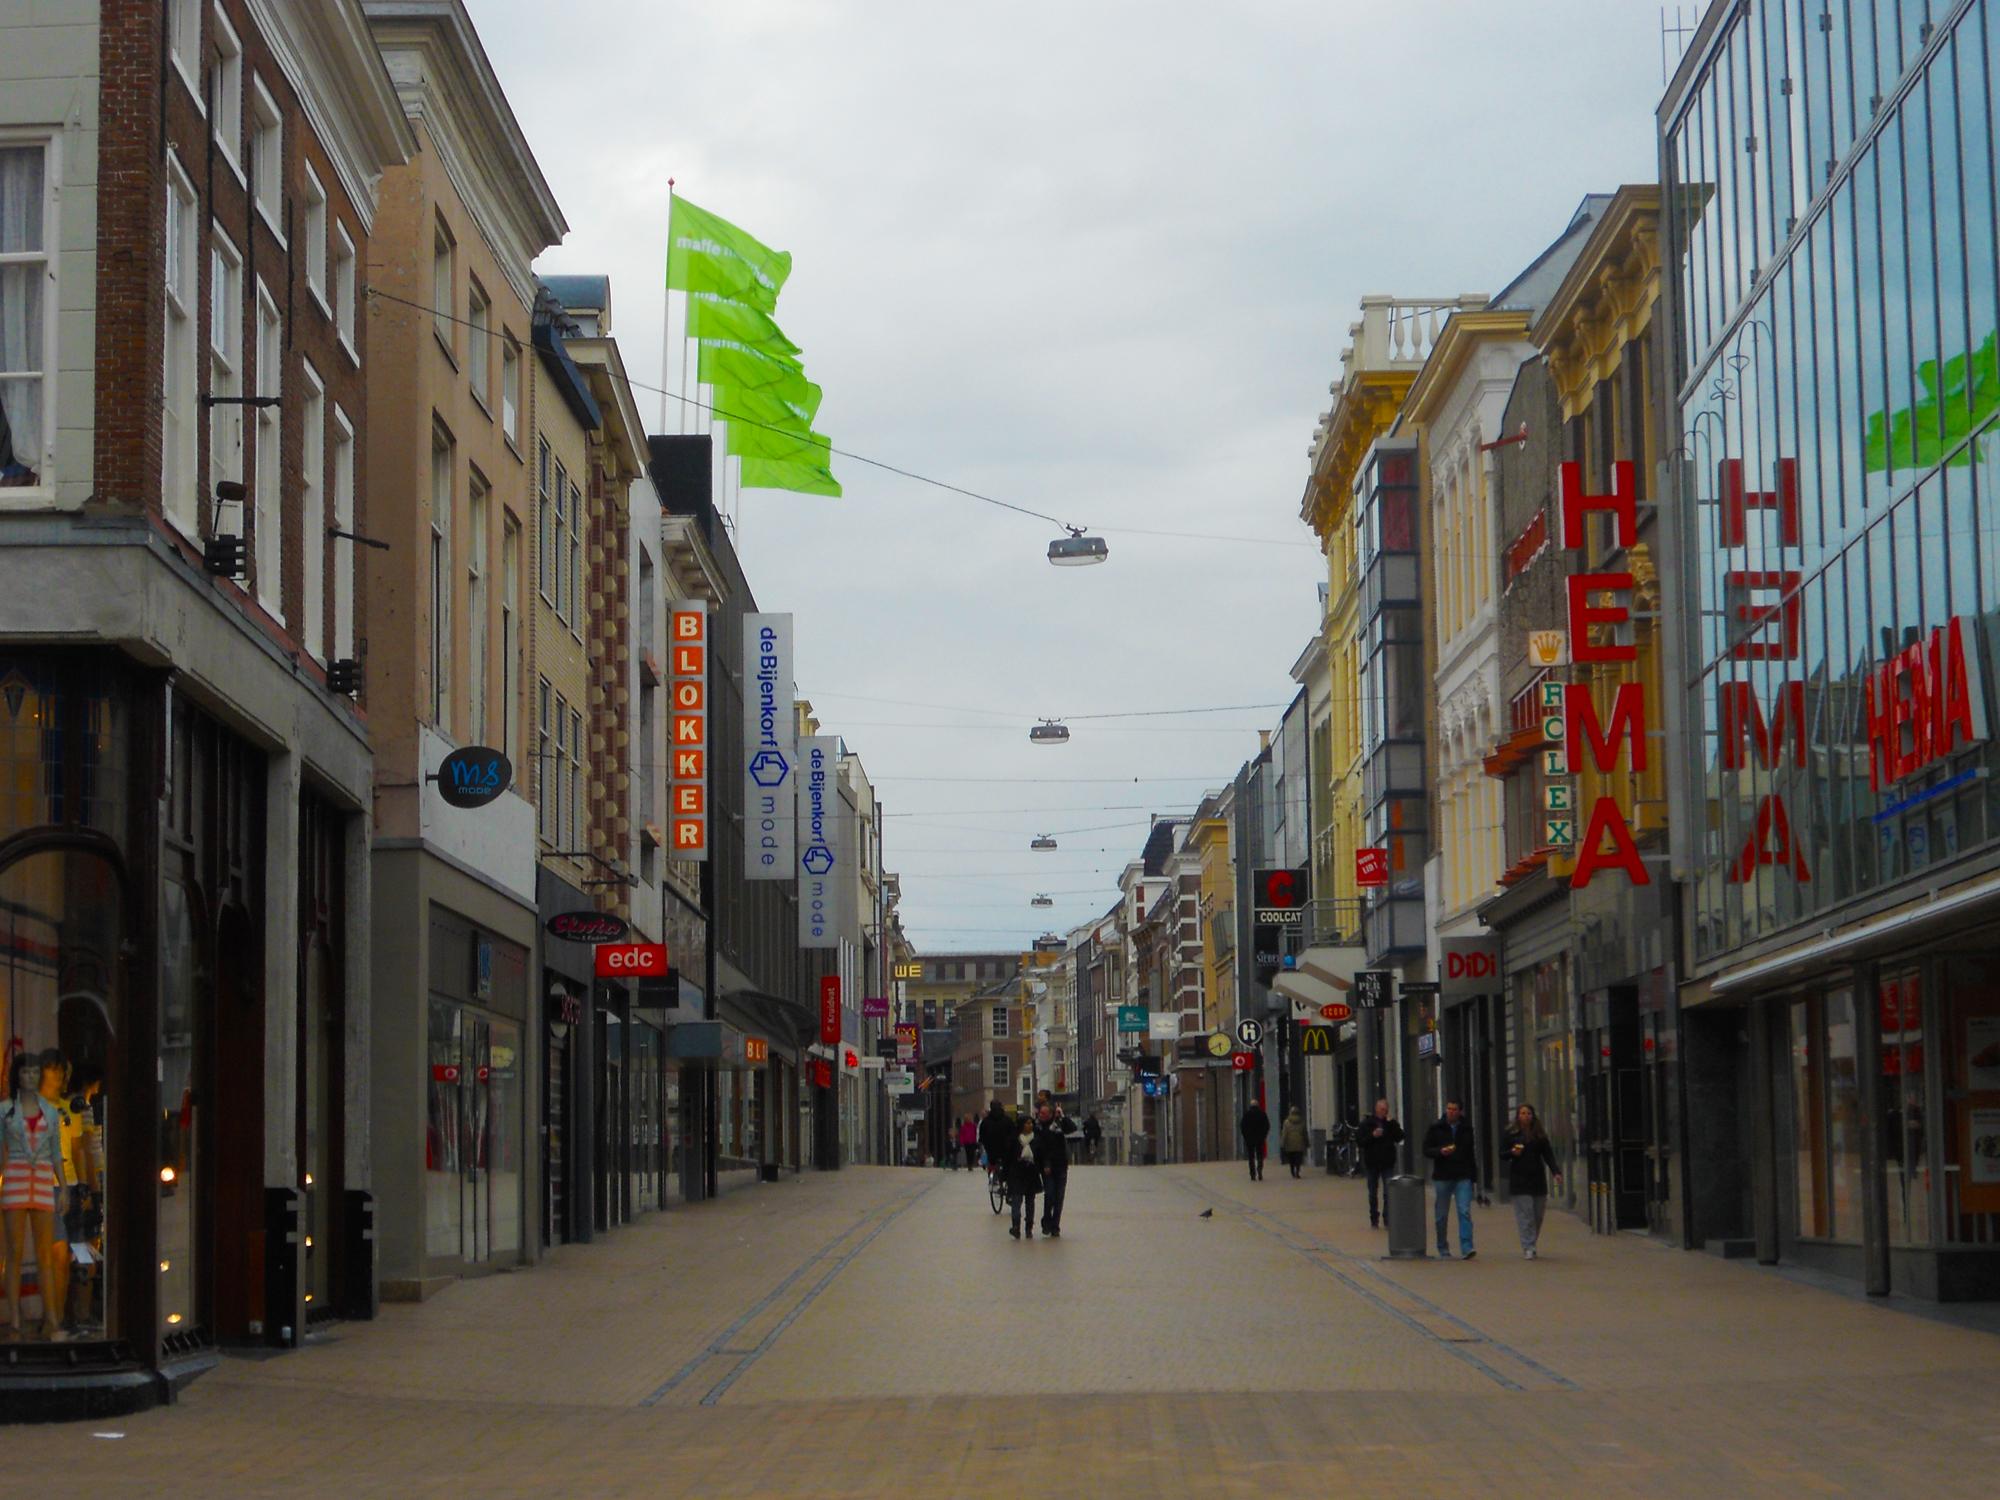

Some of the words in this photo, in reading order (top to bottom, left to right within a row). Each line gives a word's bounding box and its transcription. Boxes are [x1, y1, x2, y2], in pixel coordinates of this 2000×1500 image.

[1558, 460, 1651, 889] HEMA
[679, 616, 699, 844] BLOKKER
[1866, 616, 1974, 793] HEMA
[1543, 683, 1571, 844] ROLEX
[761, 796, 778, 866] mode
[811, 882, 825, 938] mode
[1260, 911, 1302, 923] COOLCAT
[608, 946, 654, 969] edc
[894, 964, 922, 978] WE
[1447, 950, 1497, 978] DiDi
[1242, 1023, 1256, 1041] hi
